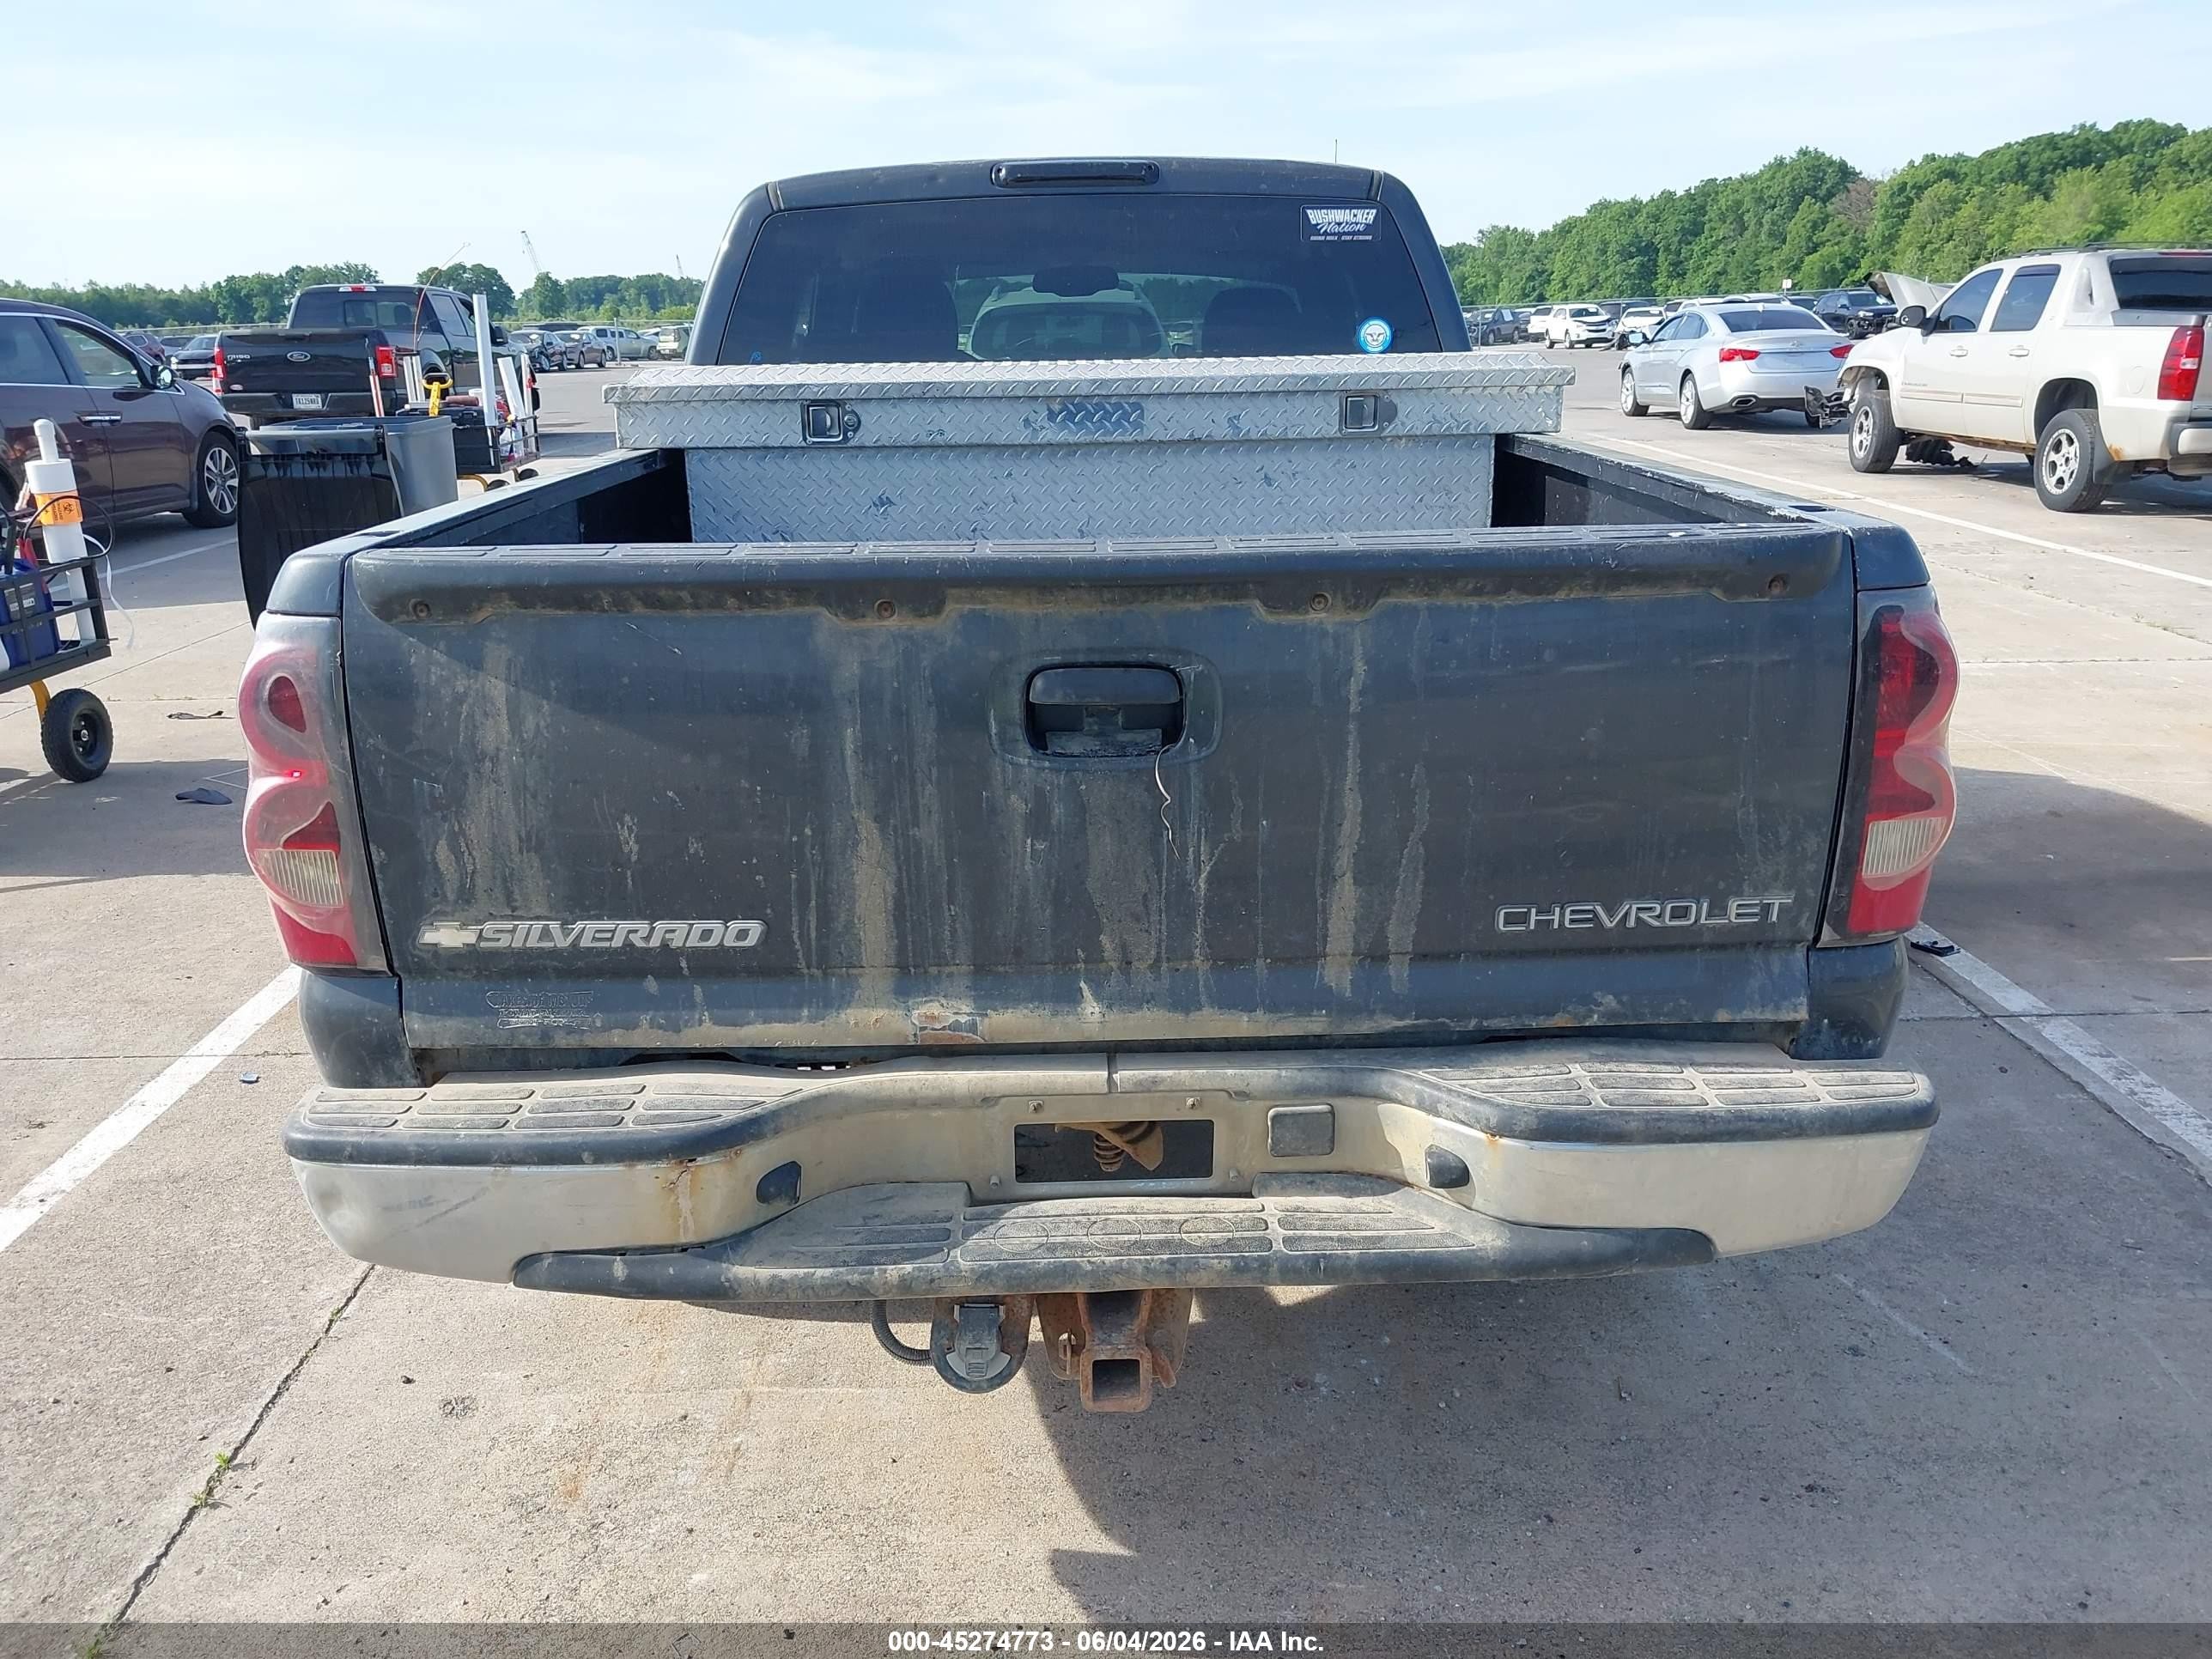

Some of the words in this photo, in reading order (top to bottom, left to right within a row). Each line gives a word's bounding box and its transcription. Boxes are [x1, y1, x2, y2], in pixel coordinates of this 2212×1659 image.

[1305, 209, 1376, 224] BUSHWACKER
[1316, 222, 1367, 234] Nation
[1496, 896, 1794, 931] CHEVROLET
[479, 920, 766, 948] SILVERADO
